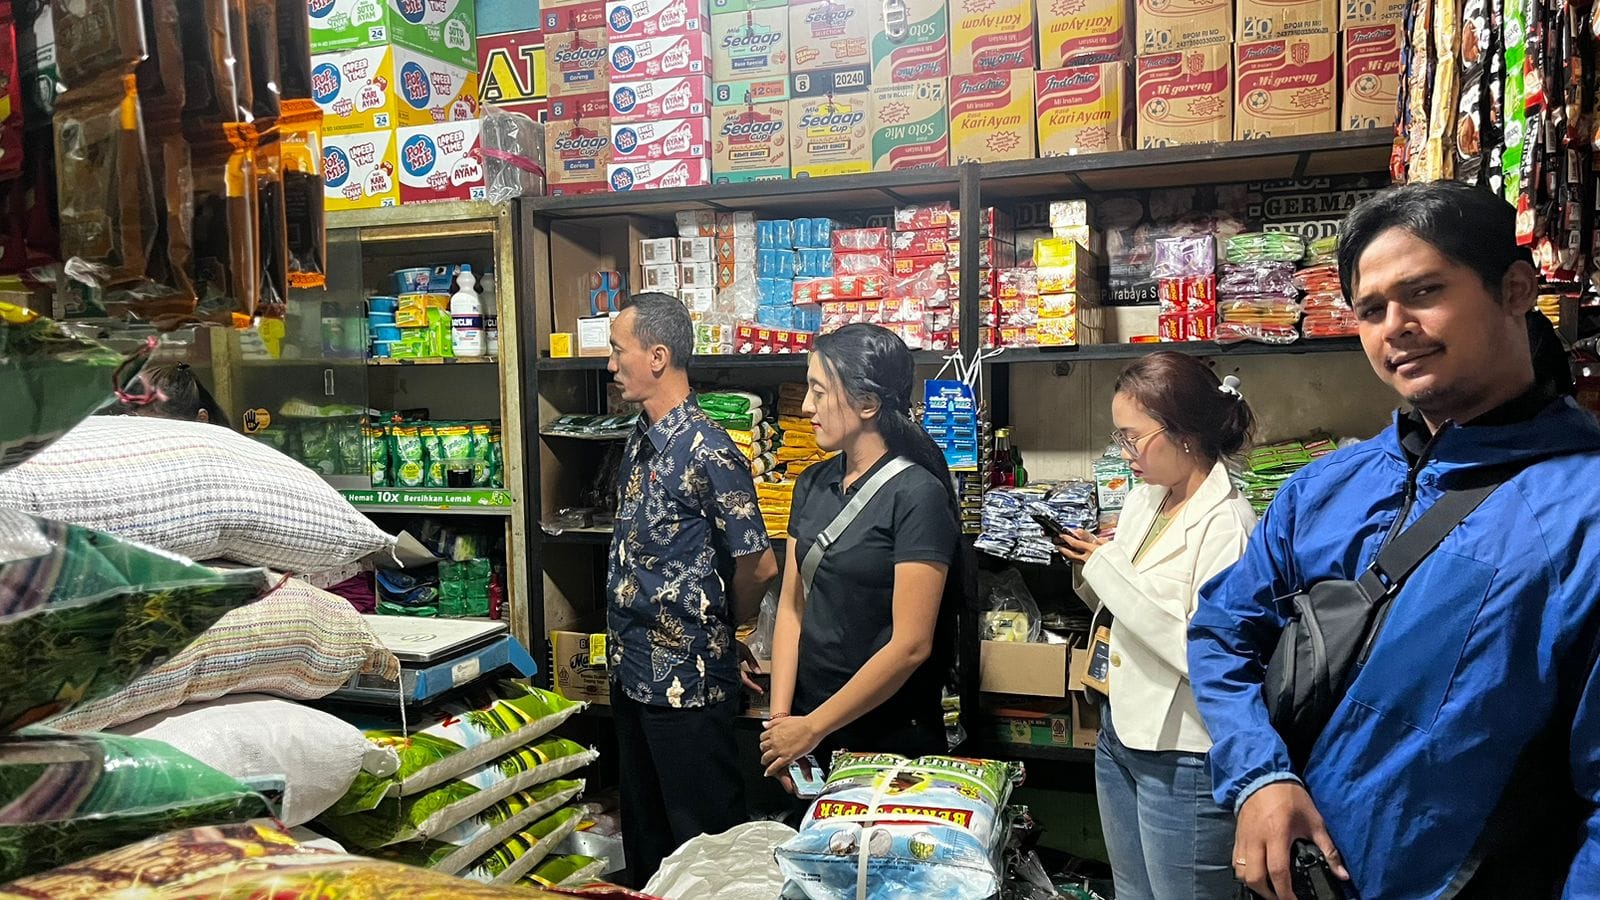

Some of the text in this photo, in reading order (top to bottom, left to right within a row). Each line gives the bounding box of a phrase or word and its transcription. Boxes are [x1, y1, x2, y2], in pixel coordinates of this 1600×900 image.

[357, 4, 375, 14] SOTO
[357, 12, 376, 21] AYAM
[548, 17, 556, 27] 8
[576, 14, 588, 22] 12
[661, 12, 680, 21] AYAM
[962, 14, 1022, 29] Kari Ayam
[909, 22, 936, 36] Soto
[1051, 16, 1113, 33] Kari Ayam
[721, 32, 783, 48] Sedaap
[554, 47, 608, 63] Sedaap
[664, 53, 683, 63] AYAM
[977, 50, 1026, 68] Indomie
[579, 60, 595, 68] Cup
[1362, 60, 1382, 71] Mi
[313, 69, 331, 89] POP
[404, 70, 421, 89] POP
[836, 73, 864, 85] 20240
[1045, 72, 1096, 90] Indomie
[1253, 73, 1319, 86] Mi goreng
[318, 77, 338, 98] MIE
[410, 81, 428, 99] MIE
[799, 80, 807, 91] 8
[959, 78, 1007, 94] Indomie
[1152, 82, 1213, 95] Mi goreng
[362, 91, 377, 100] KARI
[665, 95, 683, 104] AYAM
[719, 90, 728, 99] 8
[362, 98, 379, 108] AYAM
[582, 103, 593, 112] 12
[554, 106, 562, 115] 8
[376, 116, 387, 124] 24
[799, 111, 865, 128] Sedaap
[961, 115, 1021, 129] Kari Ayam
[1049, 110, 1111, 126] Kari Ayam
[720, 121, 784, 136] Sedaap
[830, 125, 847, 133] Cup
[884, 122, 935, 140] Soto Mie
[666, 137, 685, 146] AYAM
[750, 133, 768, 141] Cup
[554, 136, 609, 151] Sedaap
[405, 139, 425, 161] POP
[580, 149, 596, 157] Cup
[410, 148, 434, 170] MIE
[325, 161, 347, 181] MIE
[455, 166, 478, 180] AYAM
[662, 176, 681, 186] AYAM
[370, 183, 387, 193] AYAM
[473, 190, 484, 198] 24
[1101, 288, 1147, 302] Purabaya
[377, 492, 400, 503] 10x
[404, 494, 443, 502] Bersihkan
